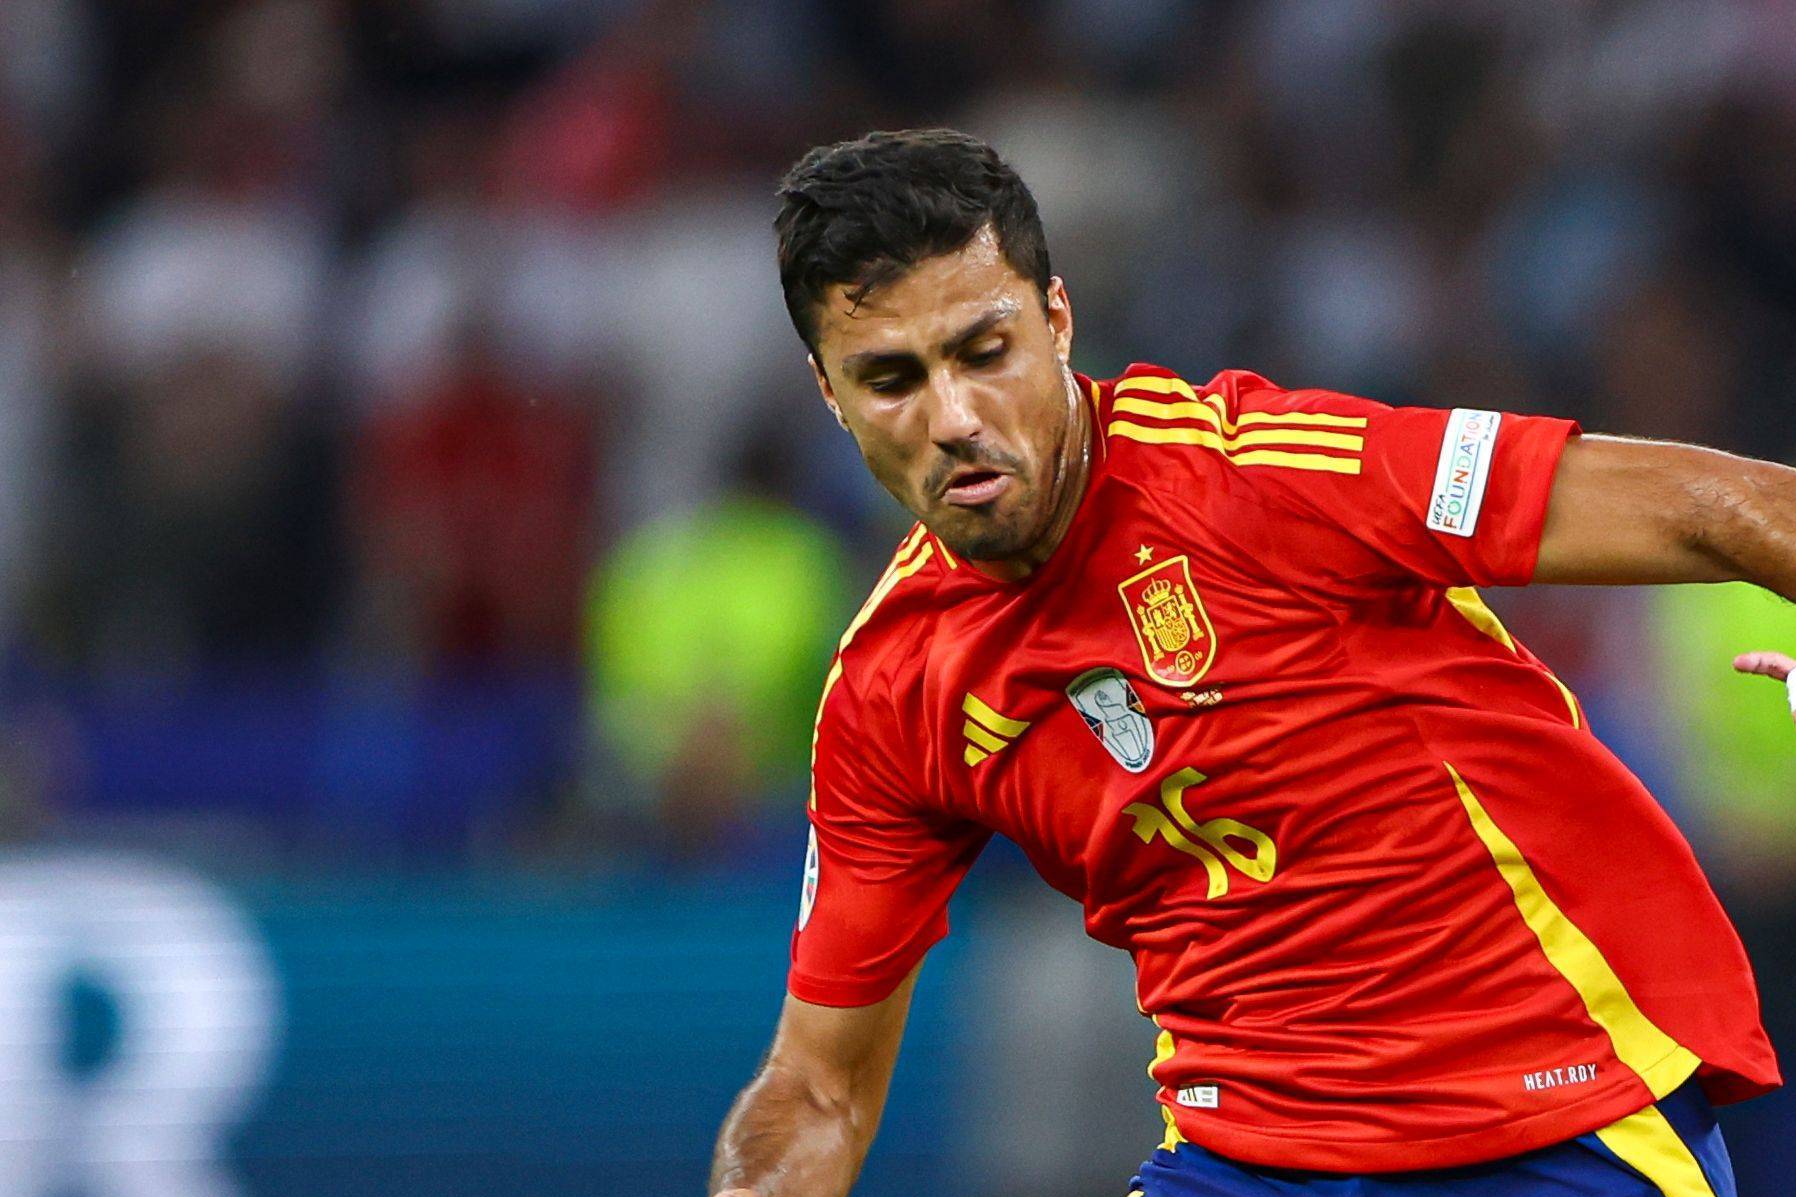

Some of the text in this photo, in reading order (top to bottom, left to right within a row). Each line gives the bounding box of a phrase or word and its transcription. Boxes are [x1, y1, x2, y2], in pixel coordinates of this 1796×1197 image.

[1442, 412, 1482, 530] FOUNDATION
[1432, 494, 1446, 526] UEFA
[1121, 766, 1277, 900] 16
[1523, 1063, 1597, 1091] HEAT.RDY
